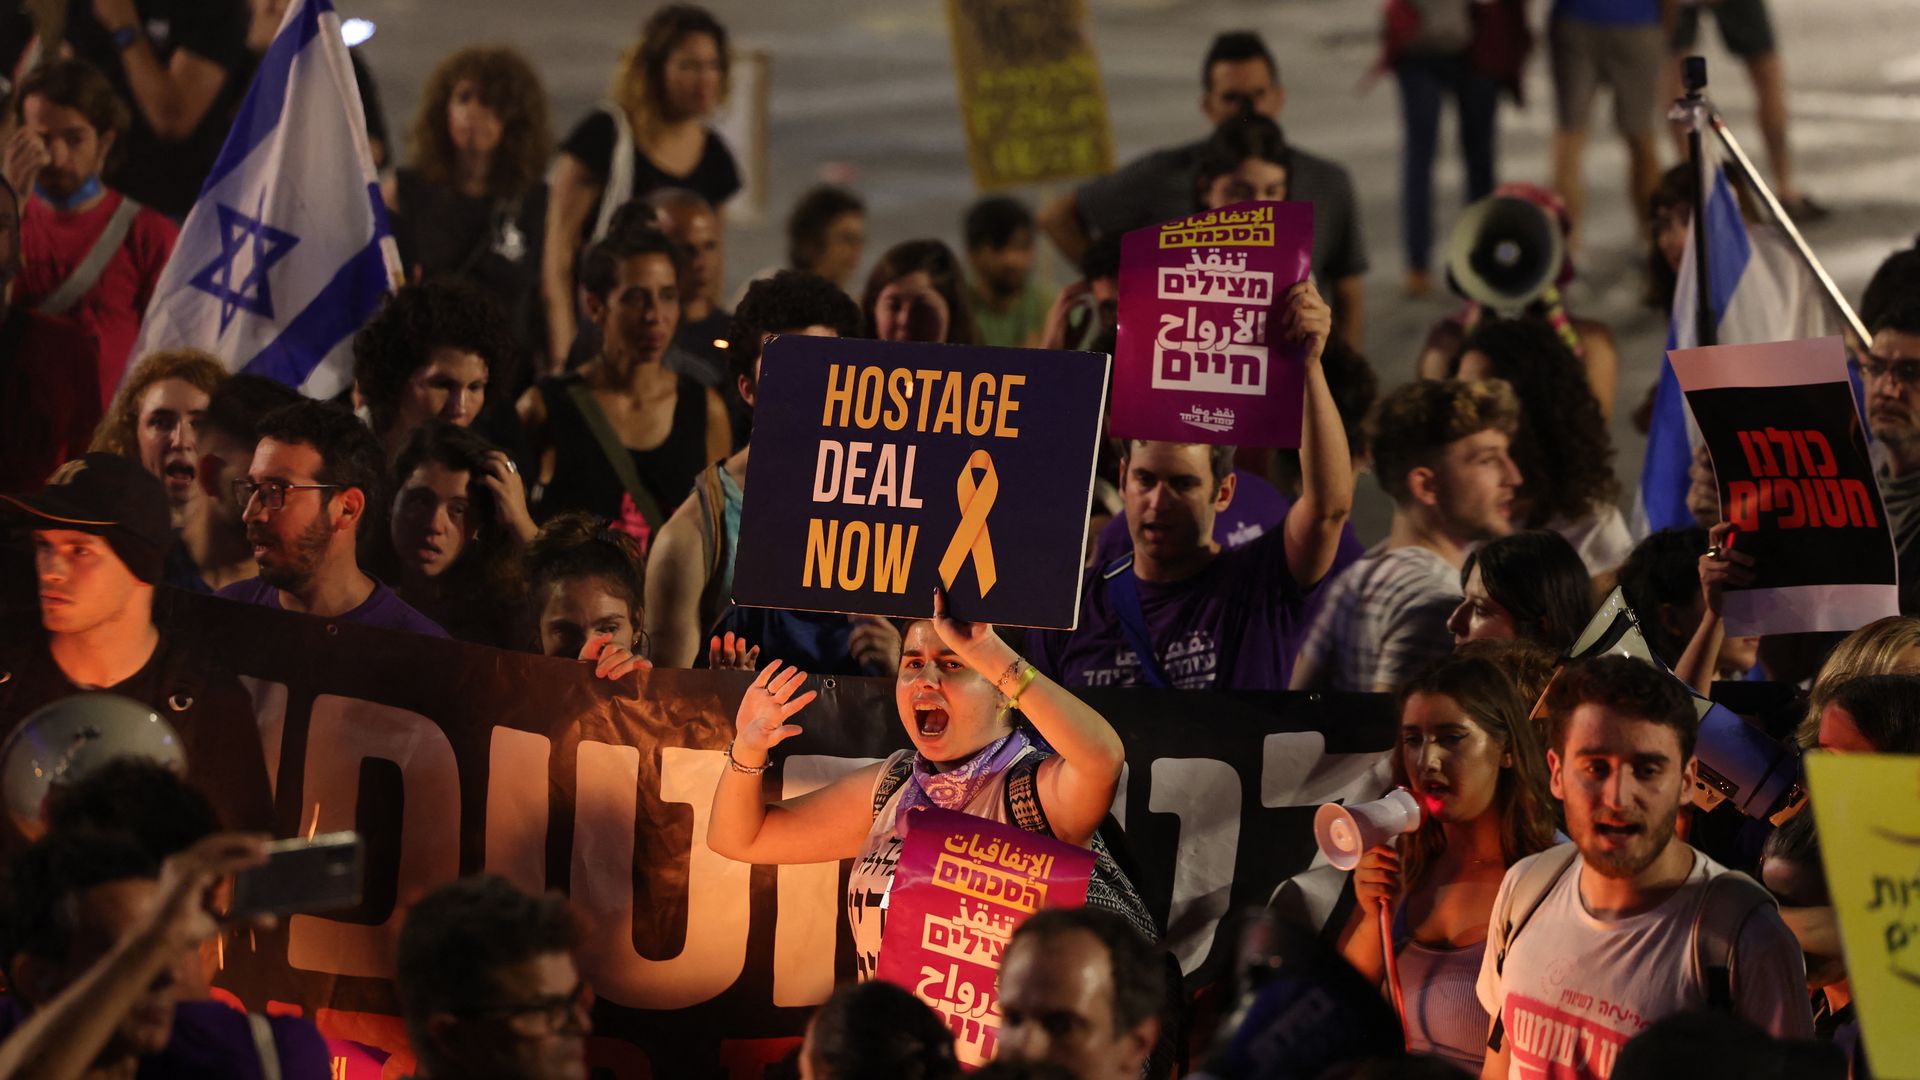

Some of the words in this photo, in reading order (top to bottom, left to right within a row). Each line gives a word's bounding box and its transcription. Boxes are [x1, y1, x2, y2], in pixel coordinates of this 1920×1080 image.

[1164, 227, 1270, 246] הסכמים
[1185, 247, 1248, 273] تنقذ
[1164, 273, 1268, 300] מצילים
[1157, 306, 1266, 350] الأرواح
[1161, 350, 1261, 387] חיים
[822, 364, 1026, 438] HOSTAGE
[812, 439, 924, 509] DEAL
[1737, 426, 1838, 477] כולנו
[1728, 477, 1879, 532] חטופים
[802, 518, 919, 594] NOW
[941, 860, 1042, 910] הסכמים
